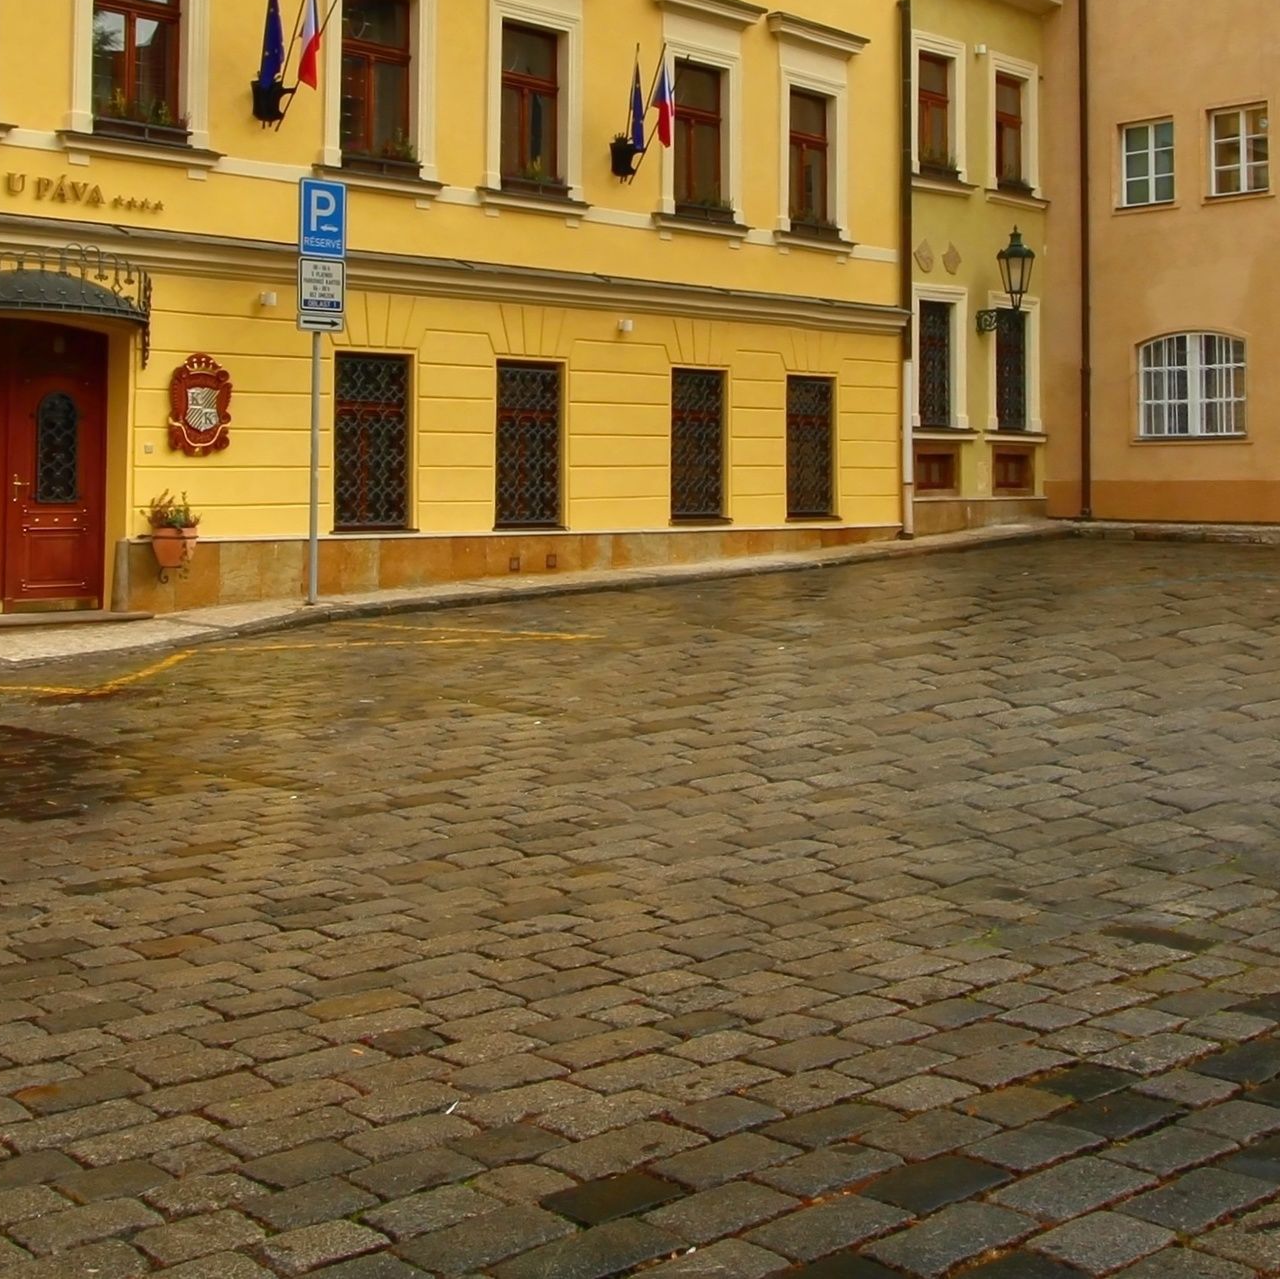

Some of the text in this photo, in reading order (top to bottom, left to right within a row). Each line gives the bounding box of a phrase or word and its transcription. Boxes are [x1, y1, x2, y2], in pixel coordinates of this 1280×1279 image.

[6, 171, 27, 196] U
[34, 174, 106, 208] PÁVA
[310, 189, 336, 231] P
[191, 391, 203, 406] K
[204, 412, 218, 425] K
